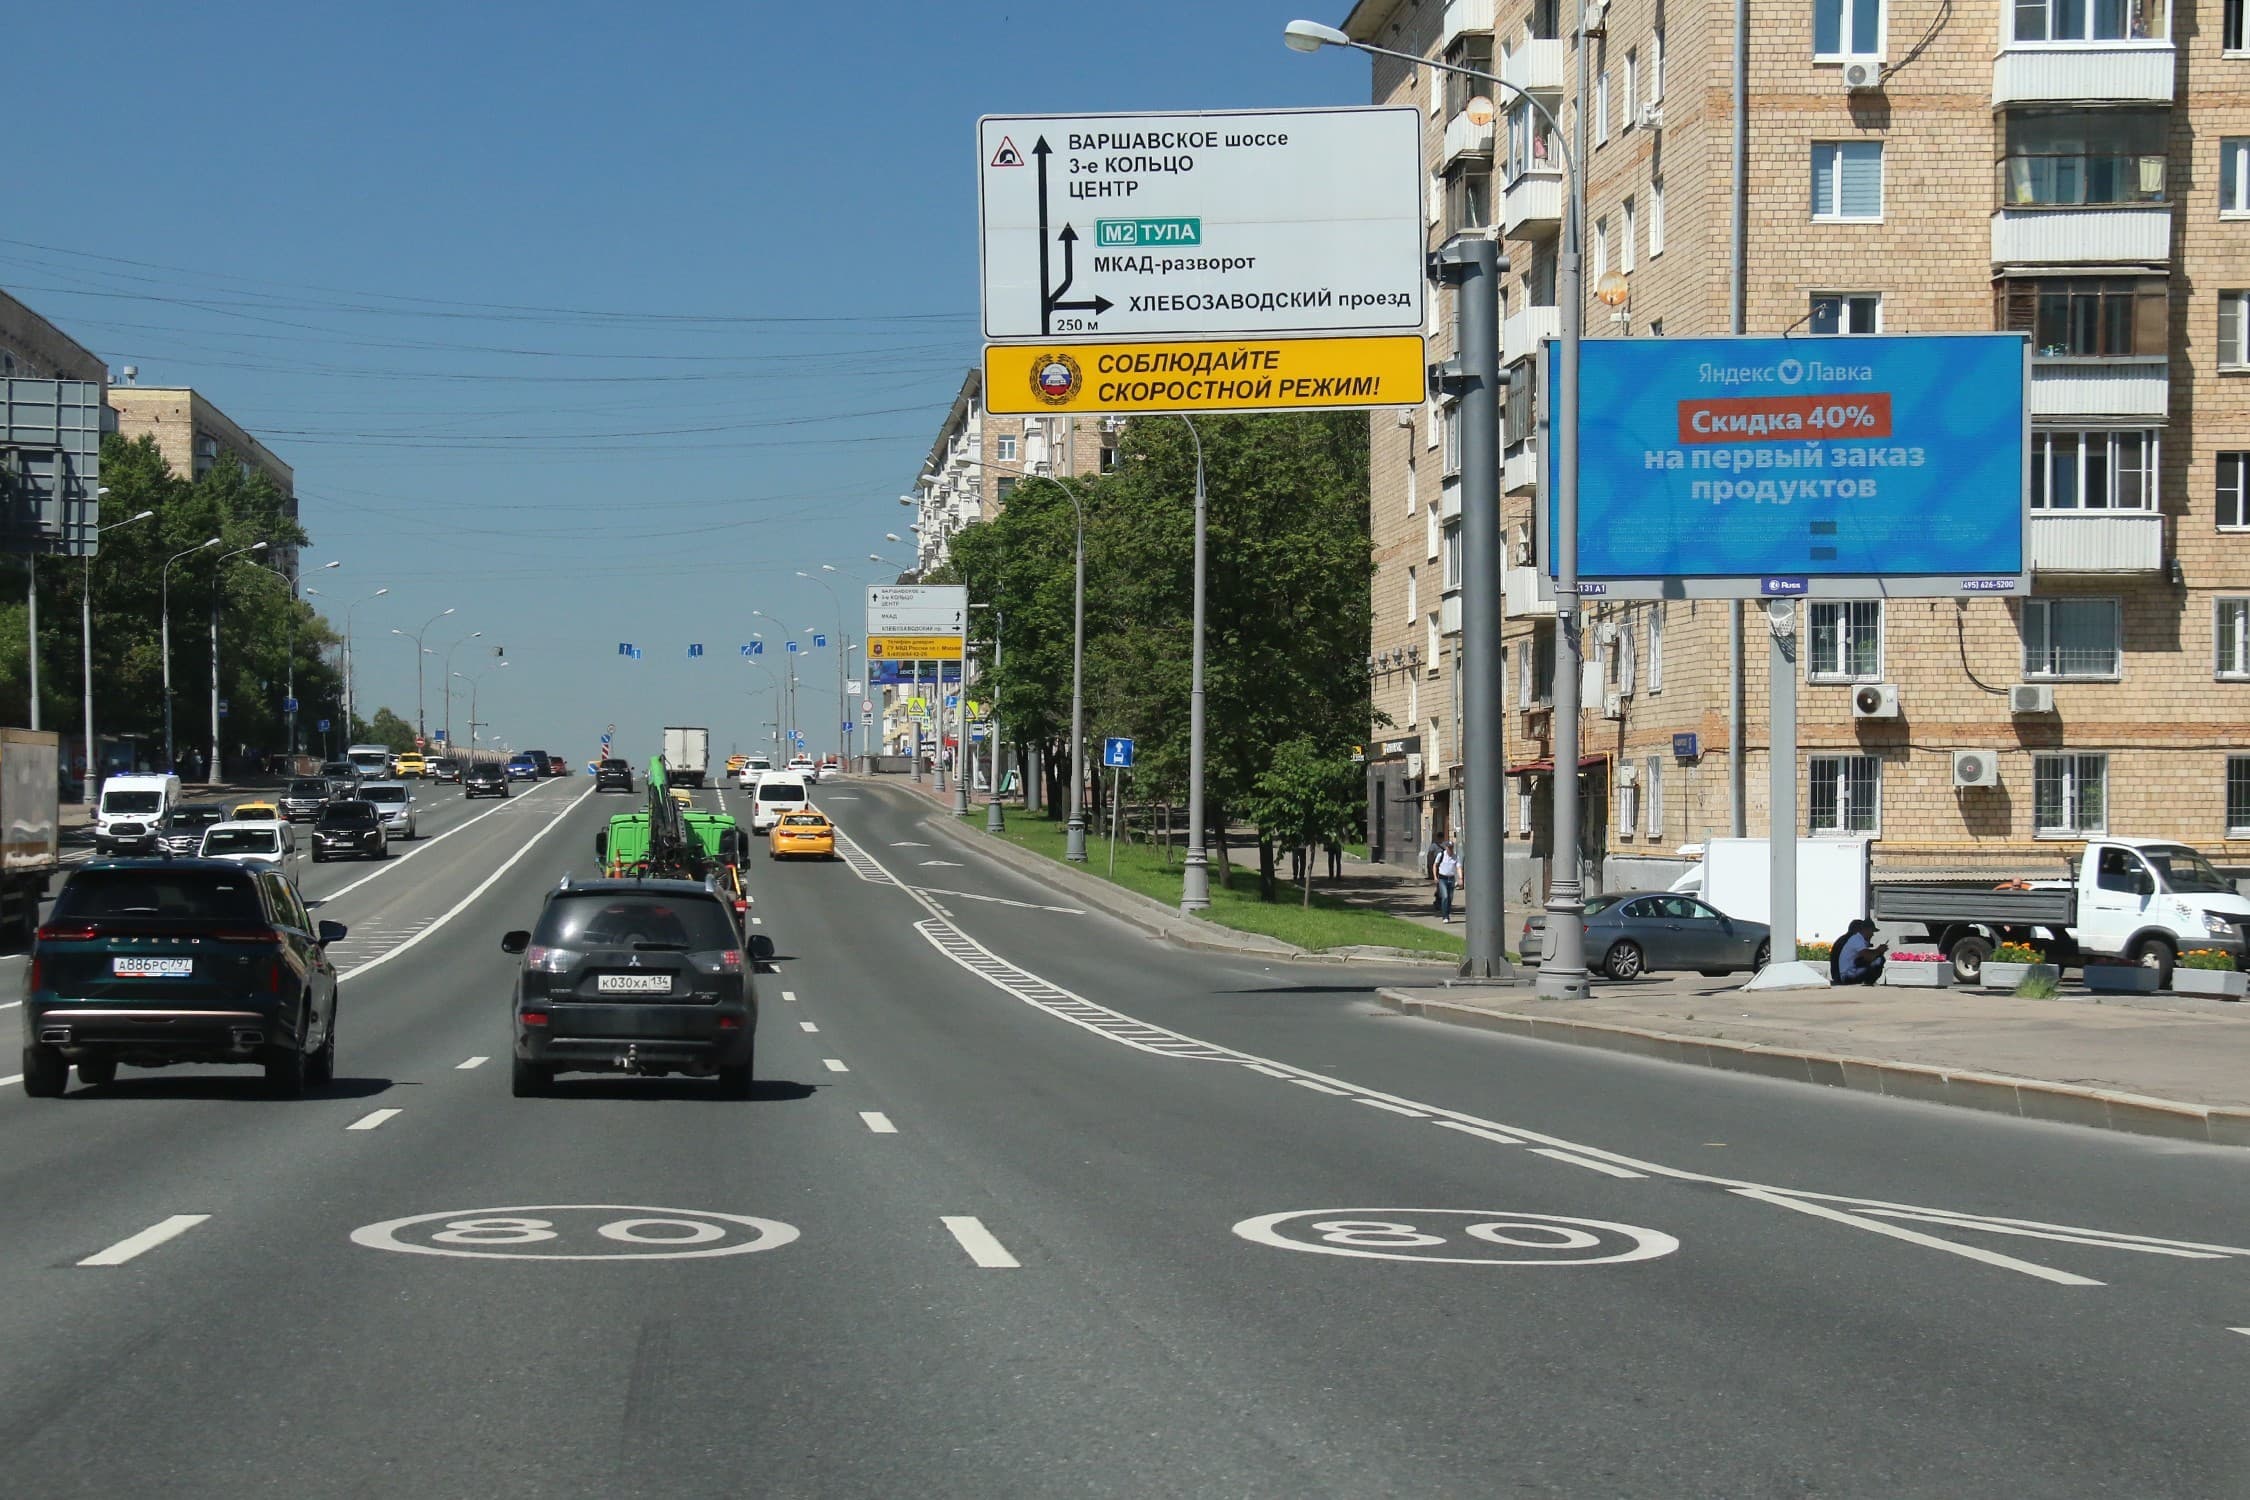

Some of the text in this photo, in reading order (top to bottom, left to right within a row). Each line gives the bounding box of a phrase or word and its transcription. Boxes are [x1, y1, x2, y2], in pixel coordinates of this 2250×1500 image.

[1069, 131, 1288, 150] ВАРШАВСКОЕ шоссе
[1069, 155, 1194, 175] 3-е КОЛЬЦО
[1069, 180, 1139, 200] ЦЕНТР
[1105, 222, 1196, 243] М2 ТУЛА
[1094, 255, 1256, 275] МКАД-разворот
[1129, 289, 1411, 312] ХЛЕБОЗАВОДСКИЙ проезд
[1057, 318, 1099, 331] 250 м
[1098, 347, 1281, 376] СОБЛЮДАЙТЕ
[1699, 361, 1873, 386] Яндекс Лавка
[1098, 375, 1381, 402] СКОРОСТНОЙ РЕЖИМ!
[1691, 405, 1876, 436] Скидка 40%
[1644, 442, 1926, 474] на первый заказ
[1690, 478, 1878, 505] продуктов
[1980, 580, 2014, 588] 626-5200
[432, 1217, 728, 1245] 80
[1311, 1220, 1602, 1250] 80
